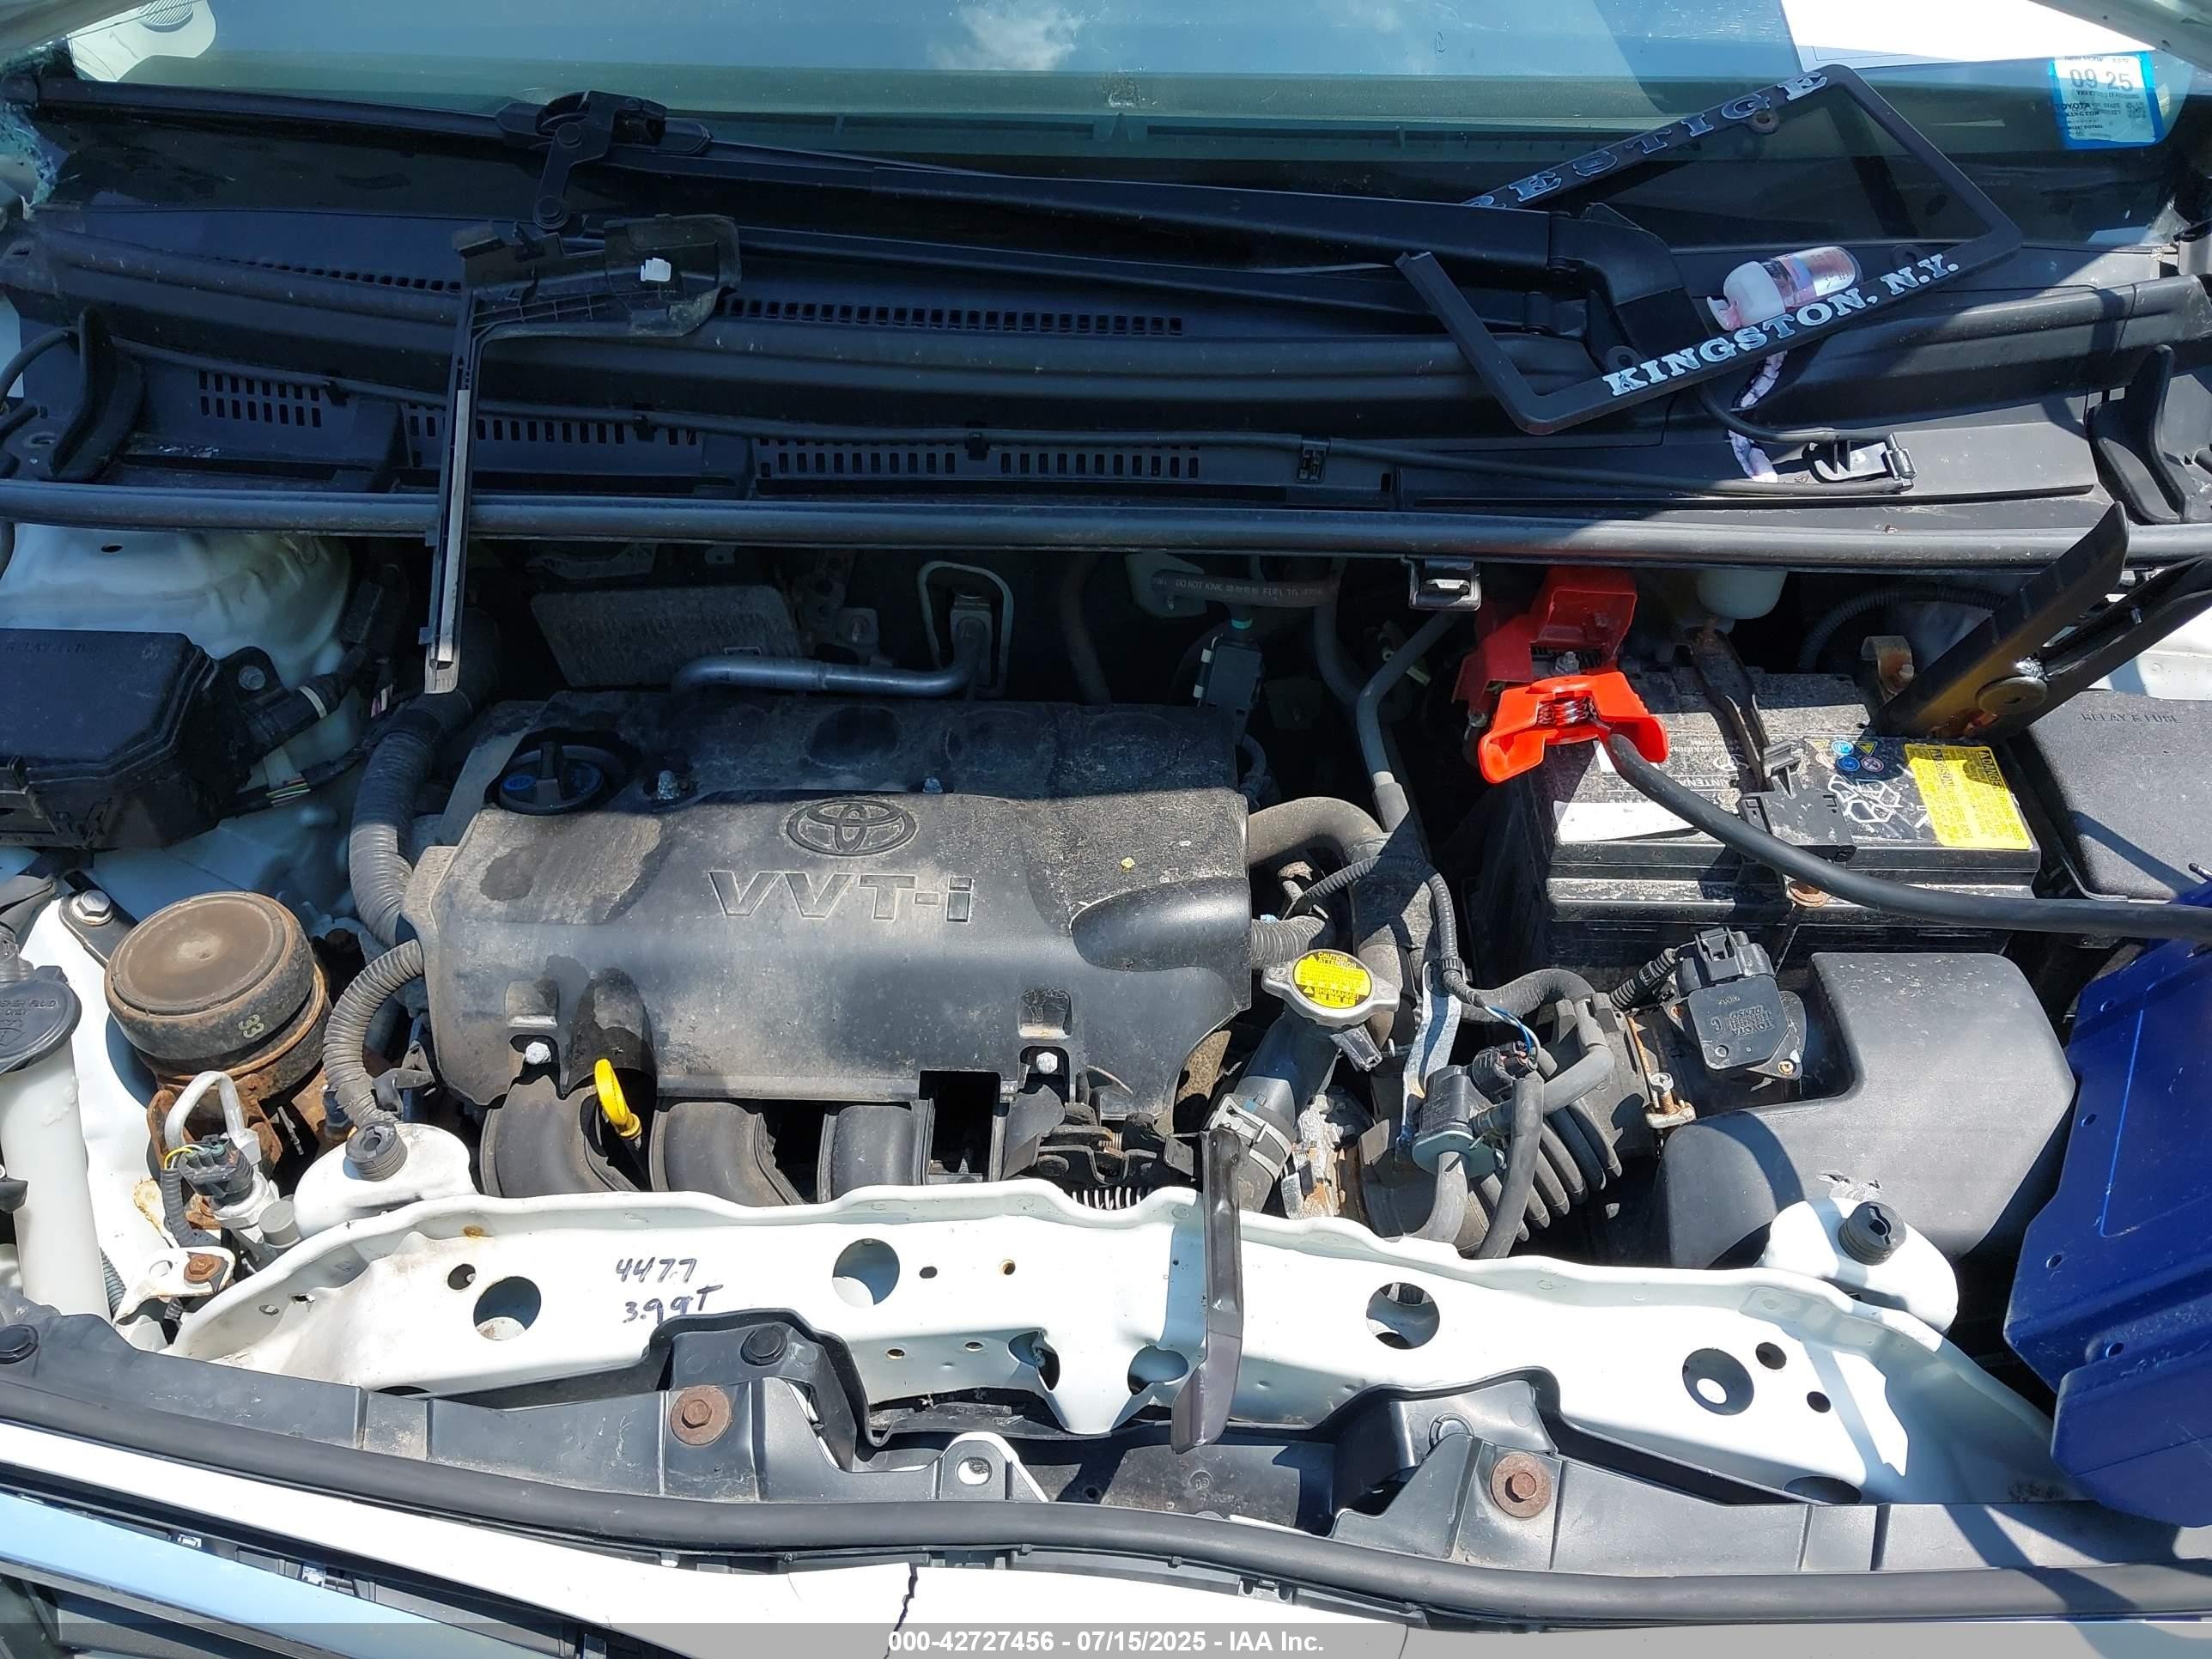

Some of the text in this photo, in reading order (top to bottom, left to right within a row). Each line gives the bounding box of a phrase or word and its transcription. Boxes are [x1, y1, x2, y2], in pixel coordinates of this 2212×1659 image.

[2069, 69, 2134, 91] 09 25
[1602, 253, 1959, 396] KINGSTON, N.Y.
[708, 871, 973, 923] VVT-i
[1318, 952, 1348, 962] CAUTION
